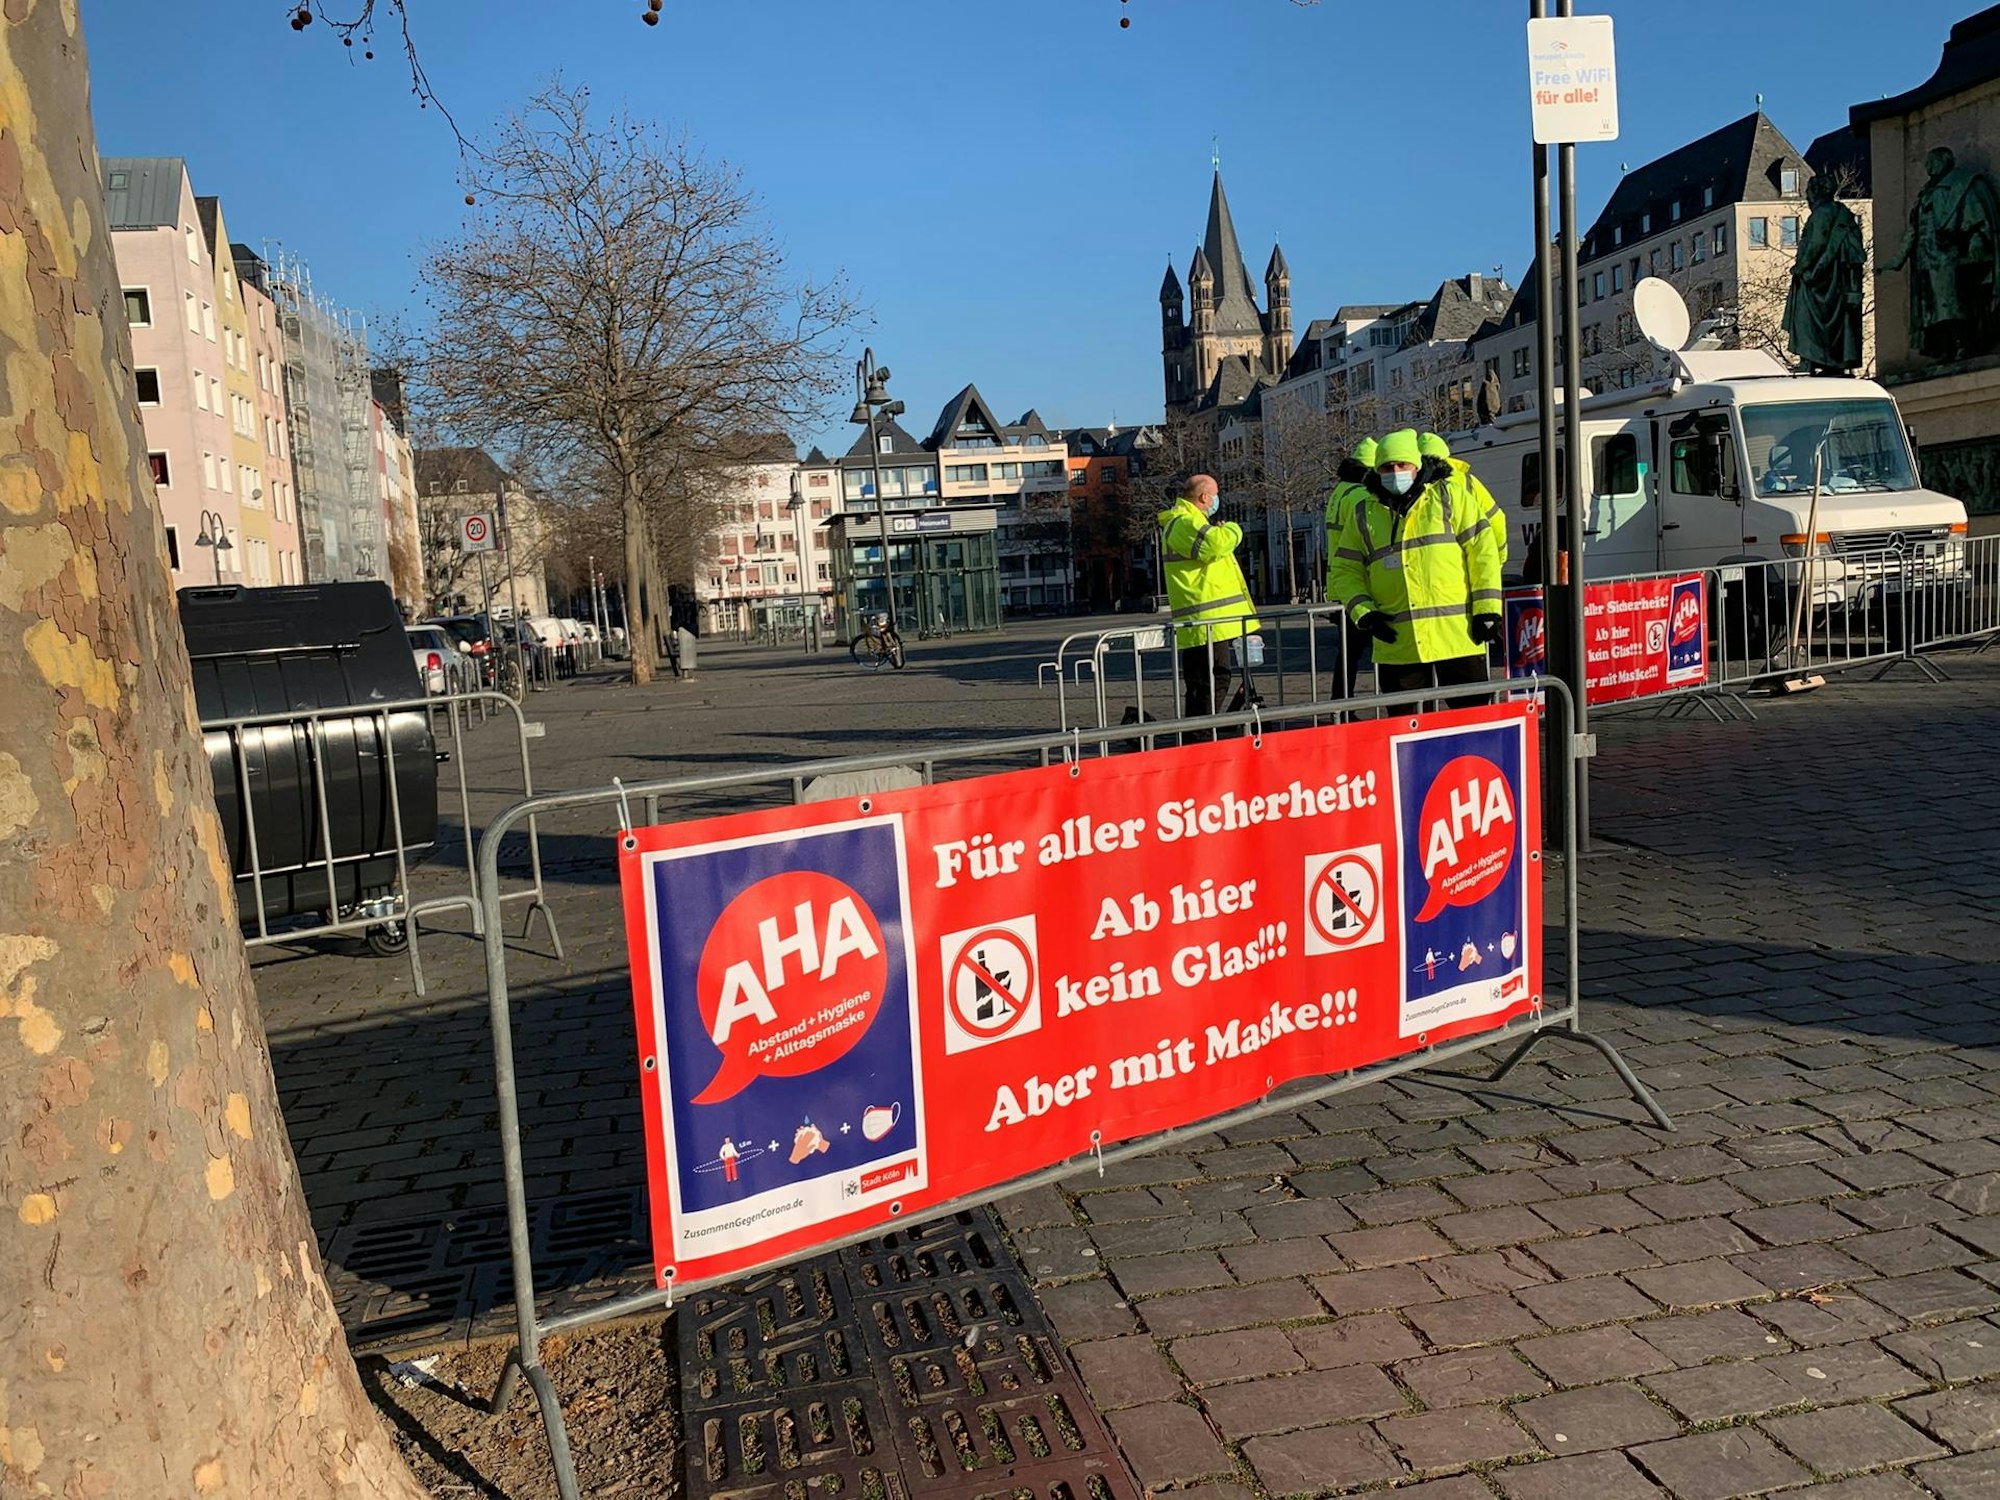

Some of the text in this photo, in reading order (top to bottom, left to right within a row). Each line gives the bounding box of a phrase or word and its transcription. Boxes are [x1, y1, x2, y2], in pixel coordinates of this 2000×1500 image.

[1535, 67, 1611, 86] Free WiFi
[1535, 87, 1599, 105] für alle!
[470, 523, 483, 535] 20
[1606, 595, 1669, 614] Sicherheit!
[1673, 598, 1699, 633] AHA
[1587, 642, 1643, 662] kein Glas!!!
[1595, 627, 1609, 641] Ab
[1599, 672, 1618, 687] mit
[1618, 664, 1659, 684] Maske!!!
[933, 770, 1378, 889] Für aller Sicherheit!
[1425, 776, 1513, 880] AHA
[1442, 864, 1473, 890] Abstand
[1477, 847, 1507, 869] Hygiene
[1453, 861, 1504, 894] Alltagsmaske
[1090, 878, 1258, 941] Ab hier
[712, 896, 880, 1046] AHA
[1055, 920, 1289, 1018] kein Glas!!!
[747, 1019, 807, 1056] Abstand
[817, 990, 872, 1024] Hygiene
[773, 1009, 866, 1062] Alltagsmaske
[984, 987, 1358, 1132] Aber mit Maske!!!
[861, 1170, 901, 1189] Stadt Köln
[683, 1198, 804, 1240] ZusammenGegenCorona.de
